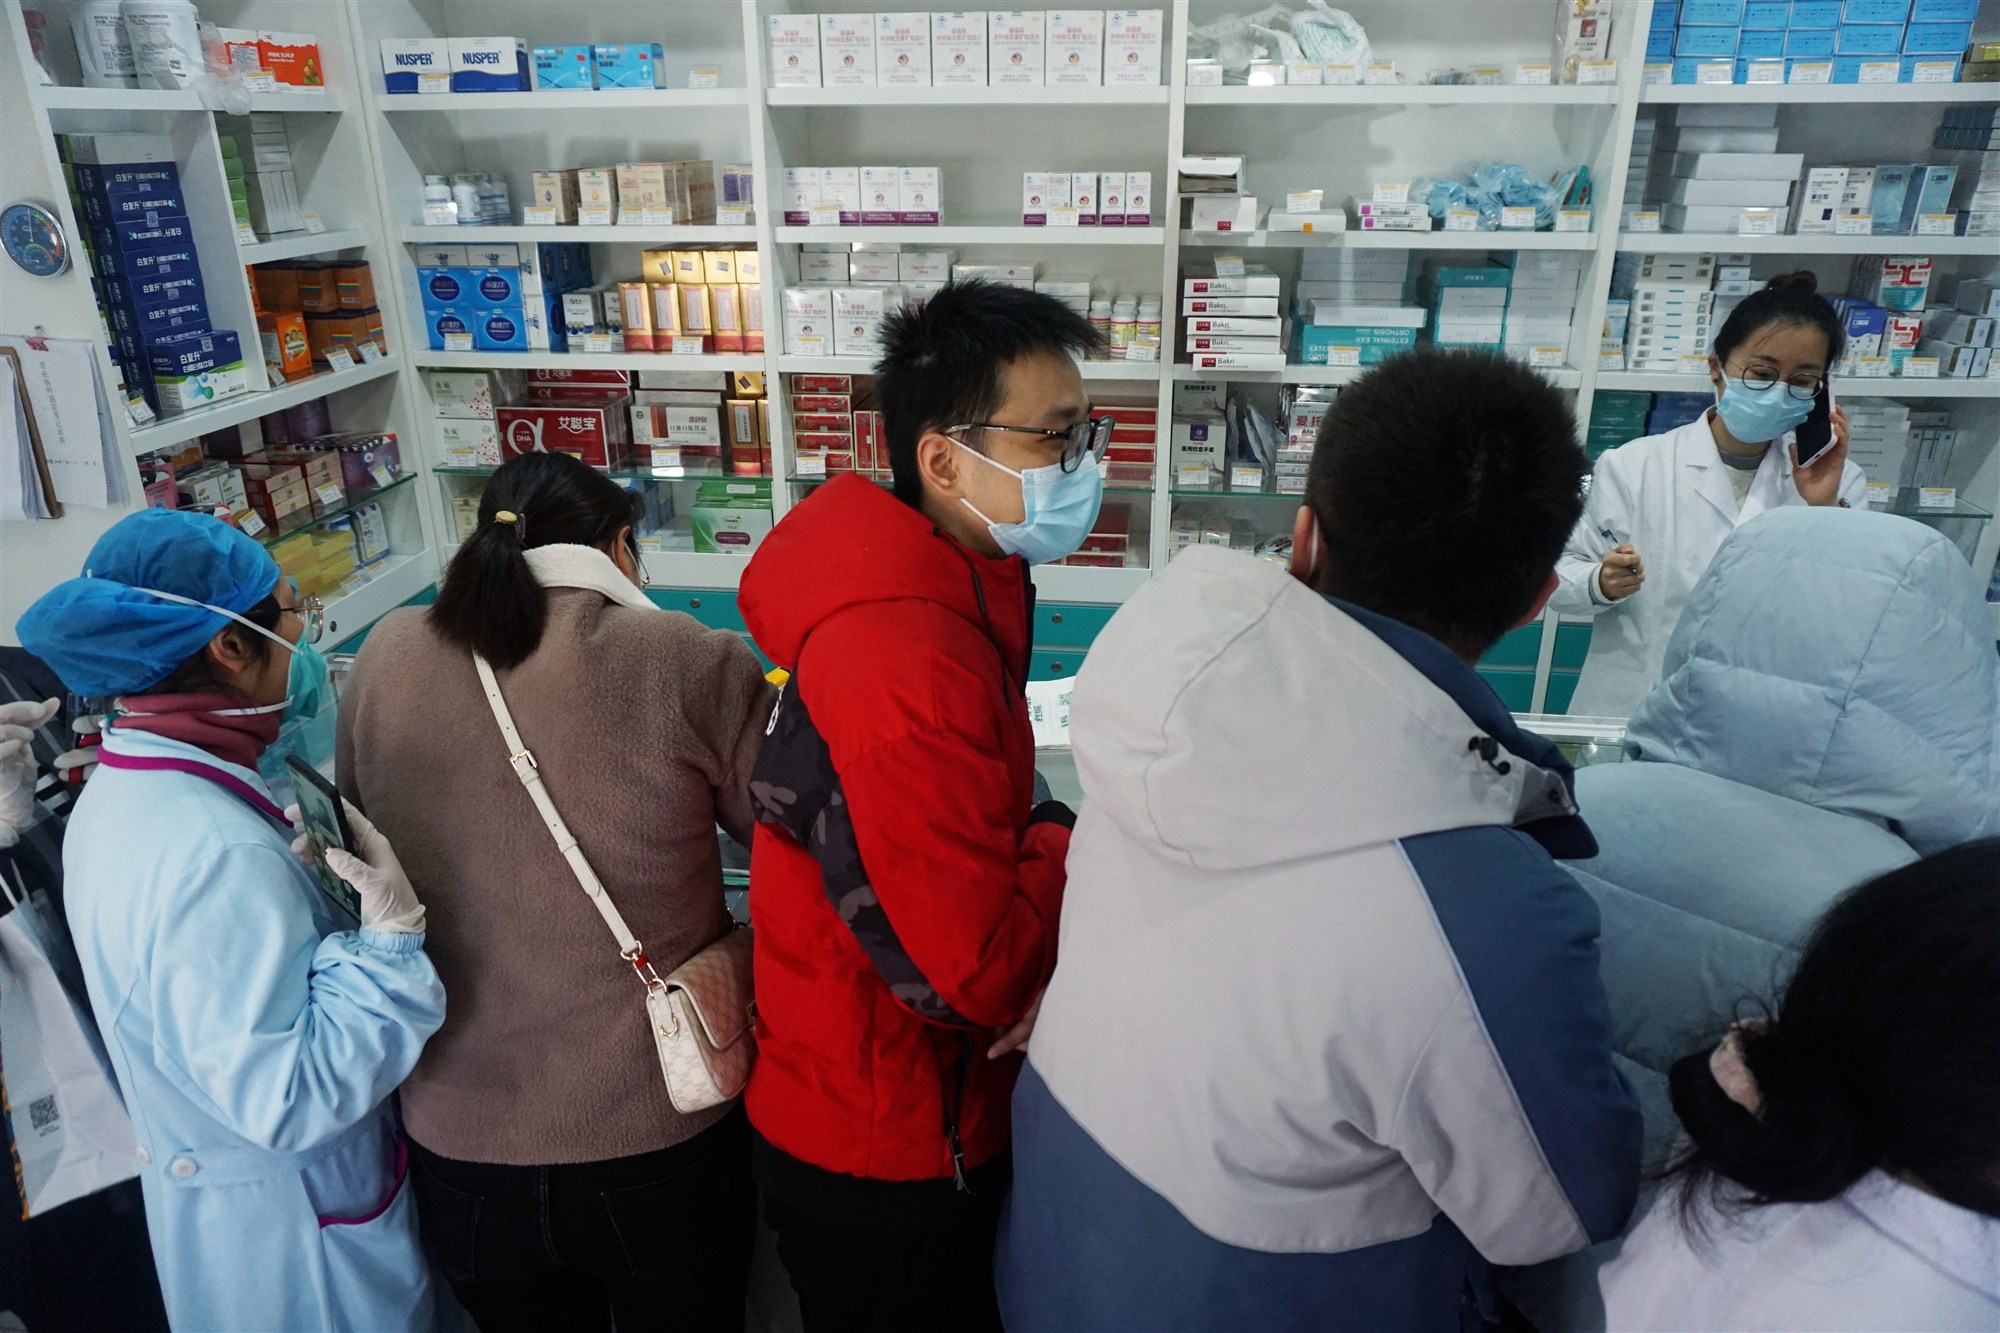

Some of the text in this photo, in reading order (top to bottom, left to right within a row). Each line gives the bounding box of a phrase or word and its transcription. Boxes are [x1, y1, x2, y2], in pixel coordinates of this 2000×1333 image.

[396, 53, 432, 65] NUSPER
[463, 52, 499, 64] NUSPER
[180, 352, 201, 364] 白复升
[558, 416, 596, 433] 艾聪宝
